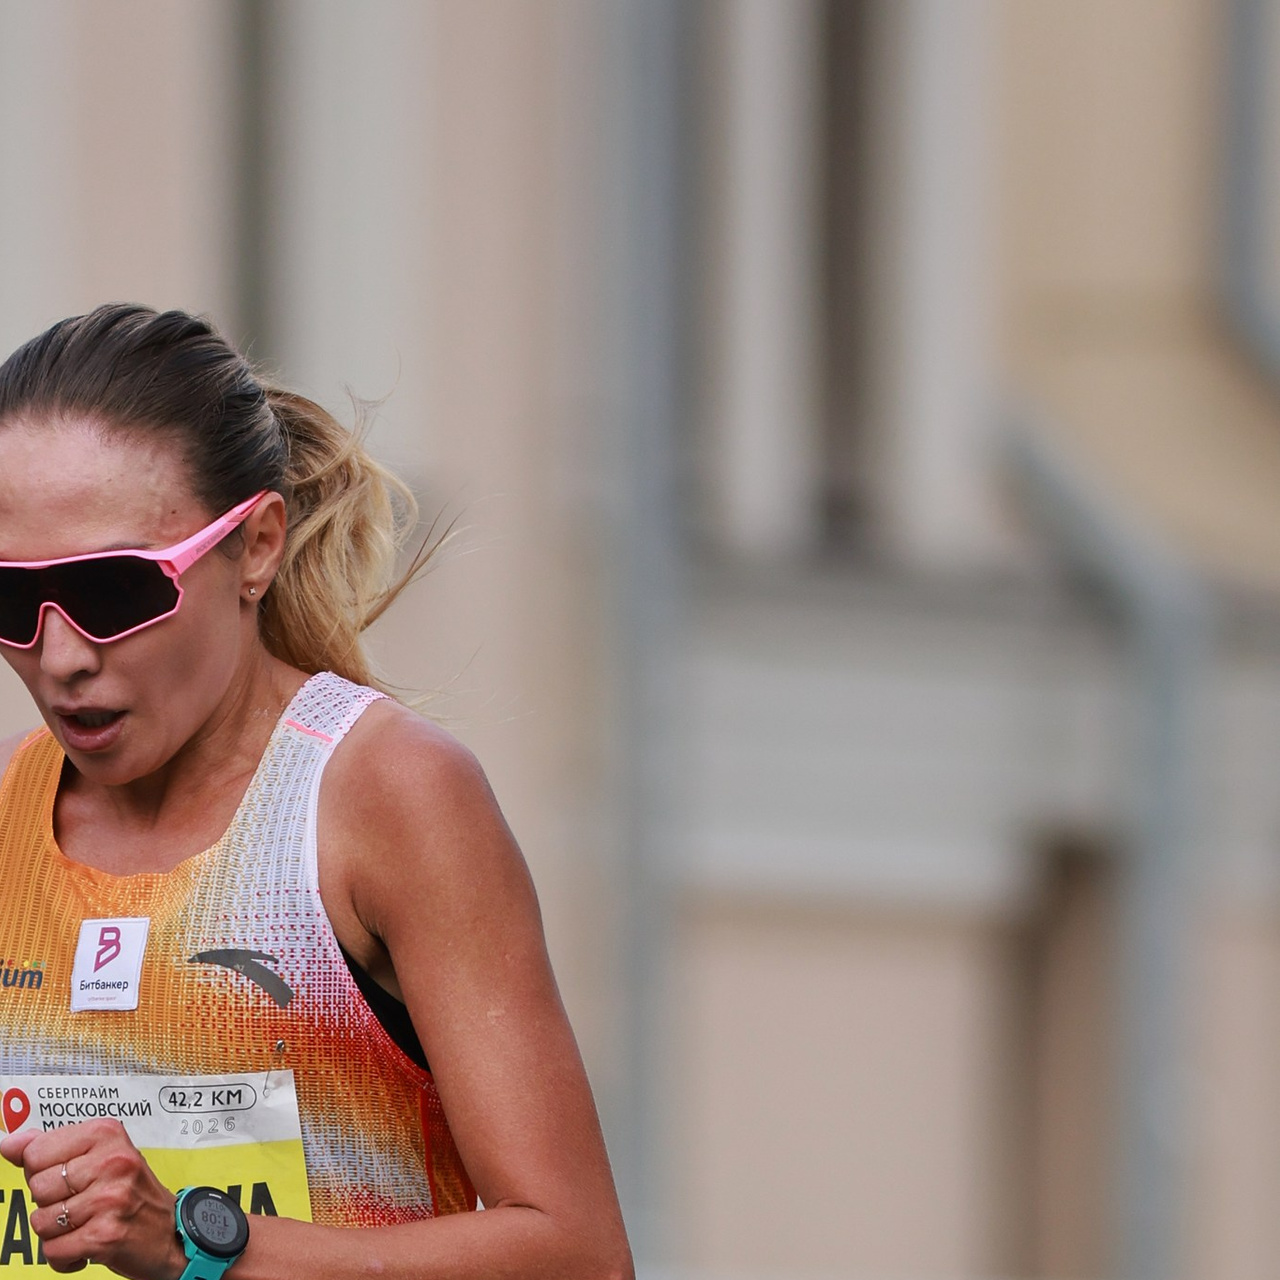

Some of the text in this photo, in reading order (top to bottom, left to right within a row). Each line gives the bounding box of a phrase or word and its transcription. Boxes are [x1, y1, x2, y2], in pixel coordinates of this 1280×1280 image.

[79, 979, 129, 992] Битбанкер
[37, 1085, 120, 1099] СБЕРПРАЙМ
[168, 1091, 203, 1109] 42,2
[39, 1099, 152, 1117] МОСКОВСКИЙ
[180, 1116, 236, 1135] 2026
